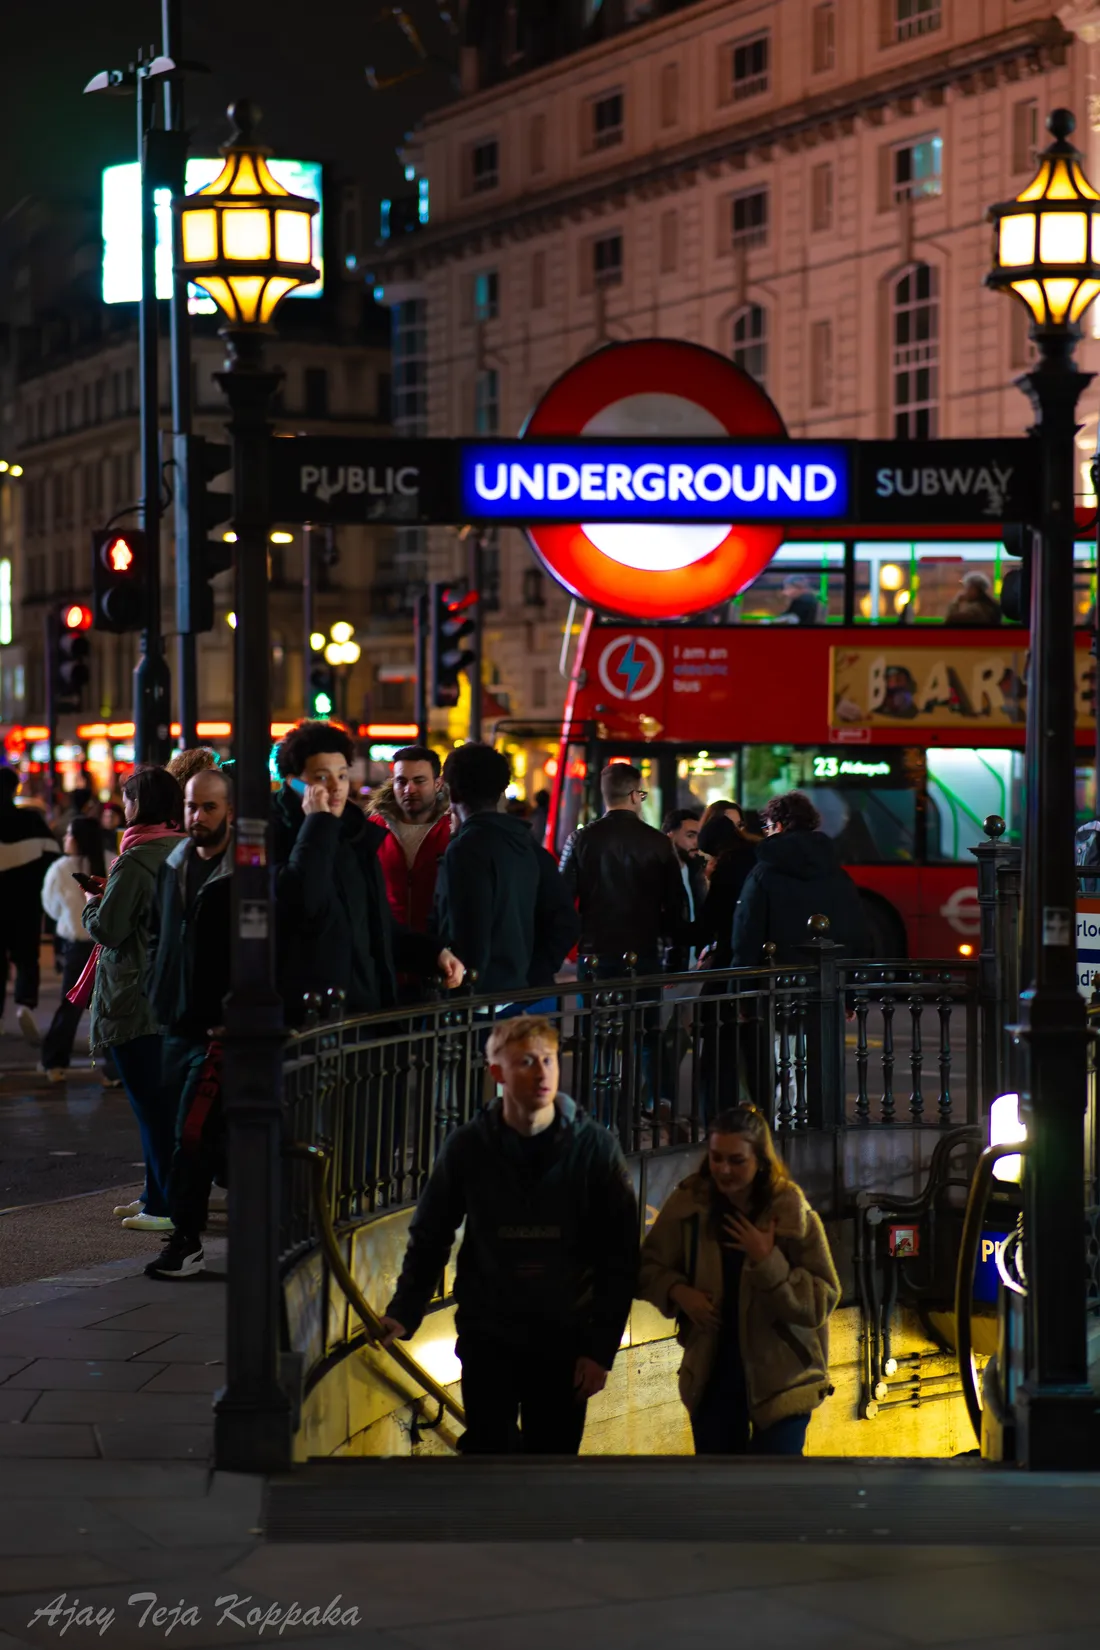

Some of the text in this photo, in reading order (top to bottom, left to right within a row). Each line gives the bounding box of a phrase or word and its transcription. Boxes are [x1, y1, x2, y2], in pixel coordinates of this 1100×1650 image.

[300, 463, 1014, 501] PUBLIC UNDERGROUND SUBWAY
[673, 645, 729, 660] I am an
[673, 678, 702, 693] bus
[813, 756, 839, 777] 23
[1076, 919, 1100, 937] rlo
